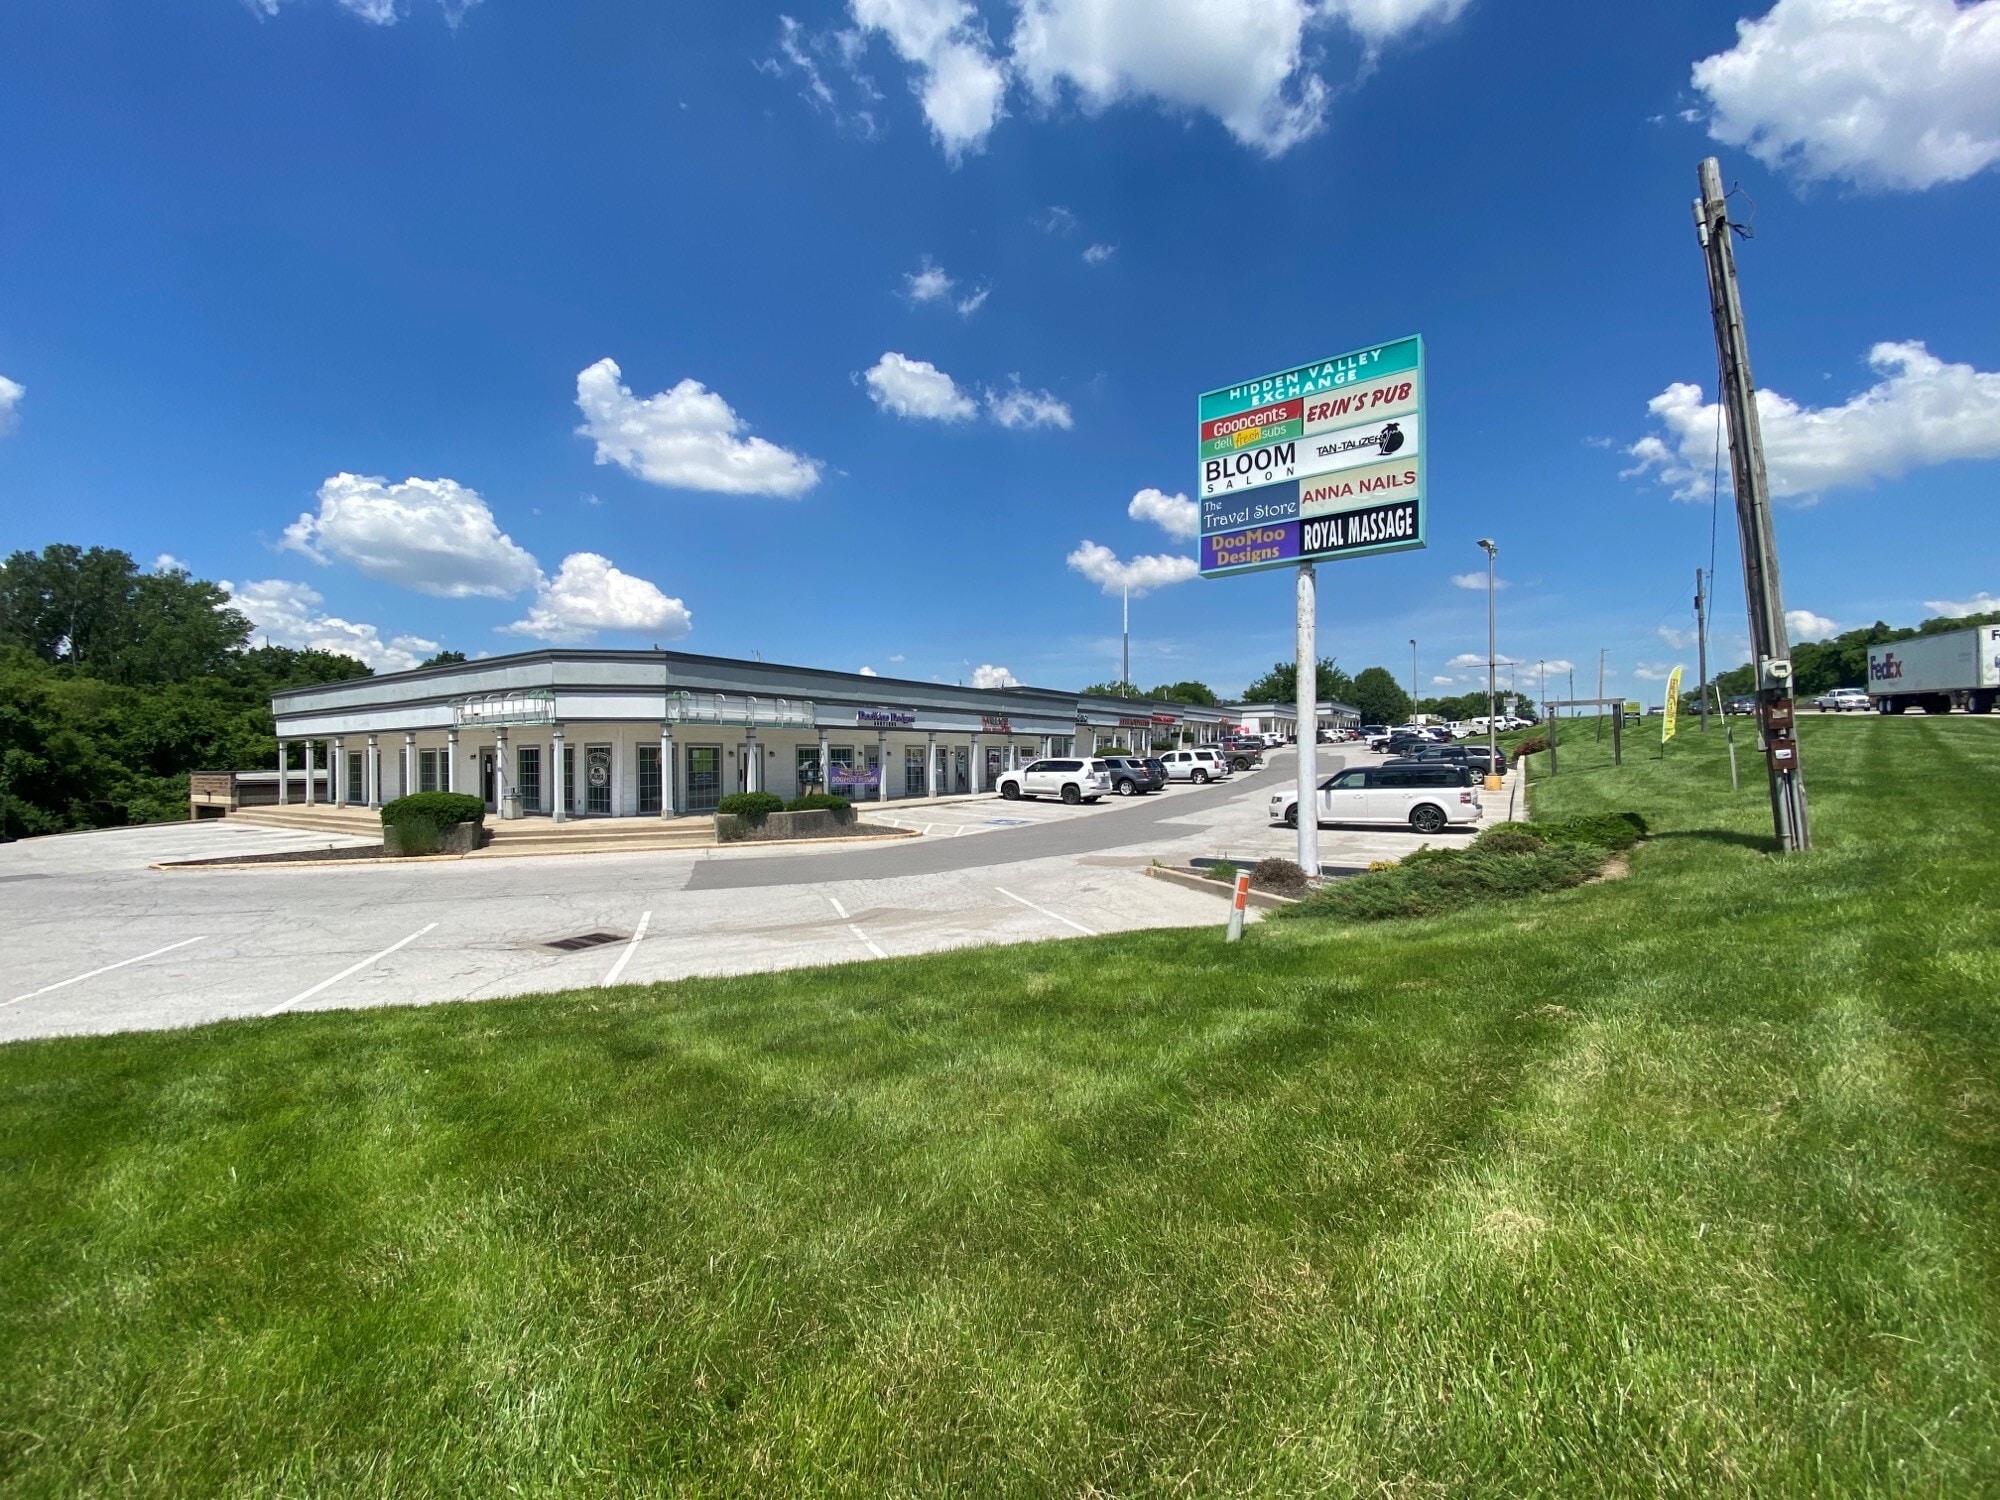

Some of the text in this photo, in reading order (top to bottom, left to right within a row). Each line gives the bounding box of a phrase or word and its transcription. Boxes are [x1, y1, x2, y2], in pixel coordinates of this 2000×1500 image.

[1230, 349, 1382, 400] HIDDEN VALLEY
[1251, 369, 1357, 407] EXCHANGE
[1306, 382, 1413, 423] ERIN'S PUB
[1214, 425, 1287, 450] deli fresh subs
[1206, 442, 1296, 482] BLOOM
[1207, 466, 1295, 493] SALON
[1302, 470, 1416, 504] ANNA NAILS
[1203, 501, 1297, 529] Travel Store
[1204, 501, 1223, 512] The
[1212, 527, 1286, 551] DooMoo
[1304, 507, 1413, 551] ROYAL MASSAGE
[1217, 546, 1280, 566] Designs
[1870, 652, 1902, 680] FedEx
